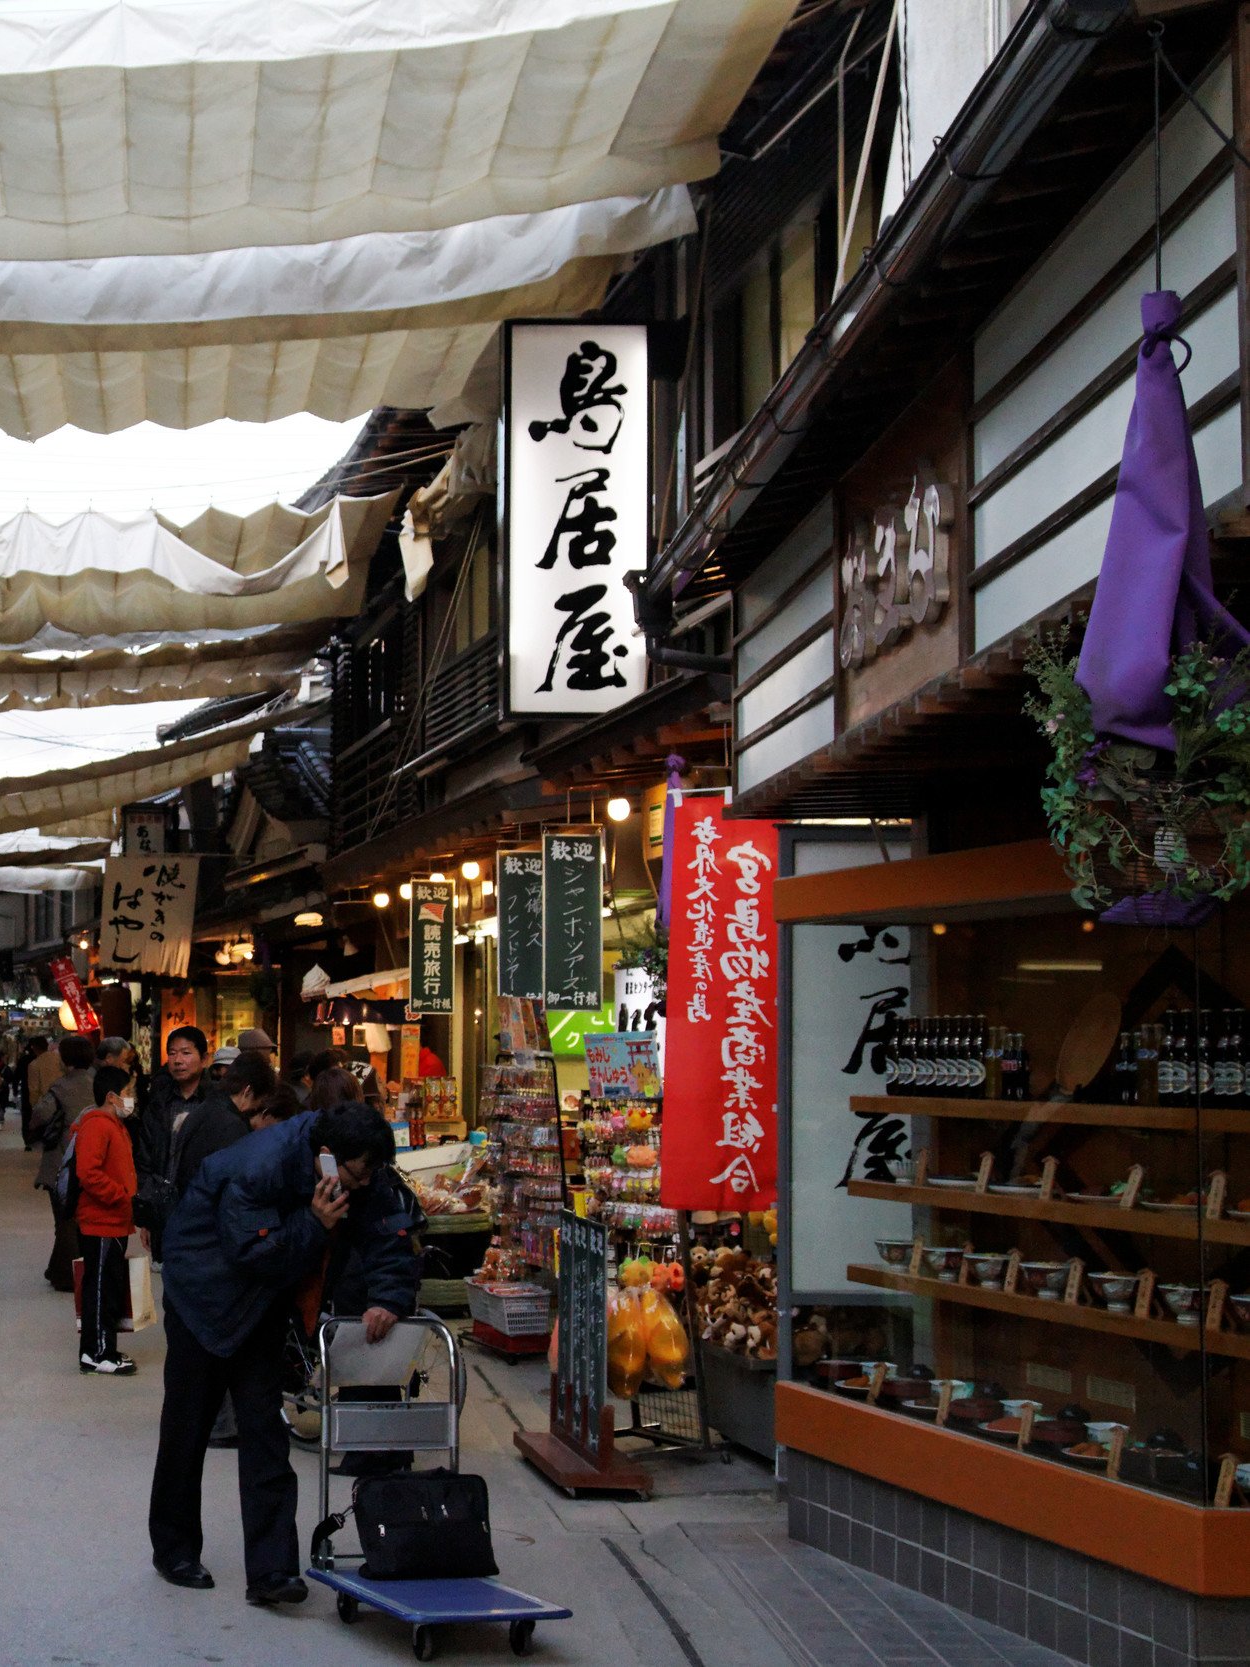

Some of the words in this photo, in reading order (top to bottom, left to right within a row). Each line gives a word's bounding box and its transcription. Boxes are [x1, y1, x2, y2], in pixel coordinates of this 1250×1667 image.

[528, 340, 629, 693] 鳥居屋
[551, 840, 595, 862] 歓迎
[504, 856, 542, 876] 歓迎
[416, 885, 450, 901] 歓迎
[108, 882, 145, 963] はやし
[562, 865, 593, 991] ジャンボツアーズ
[423, 924, 441, 996] 読売旅行
[412, 998, 452, 1011] 御一行様
[546, 991, 599, 1006] 御一行様
